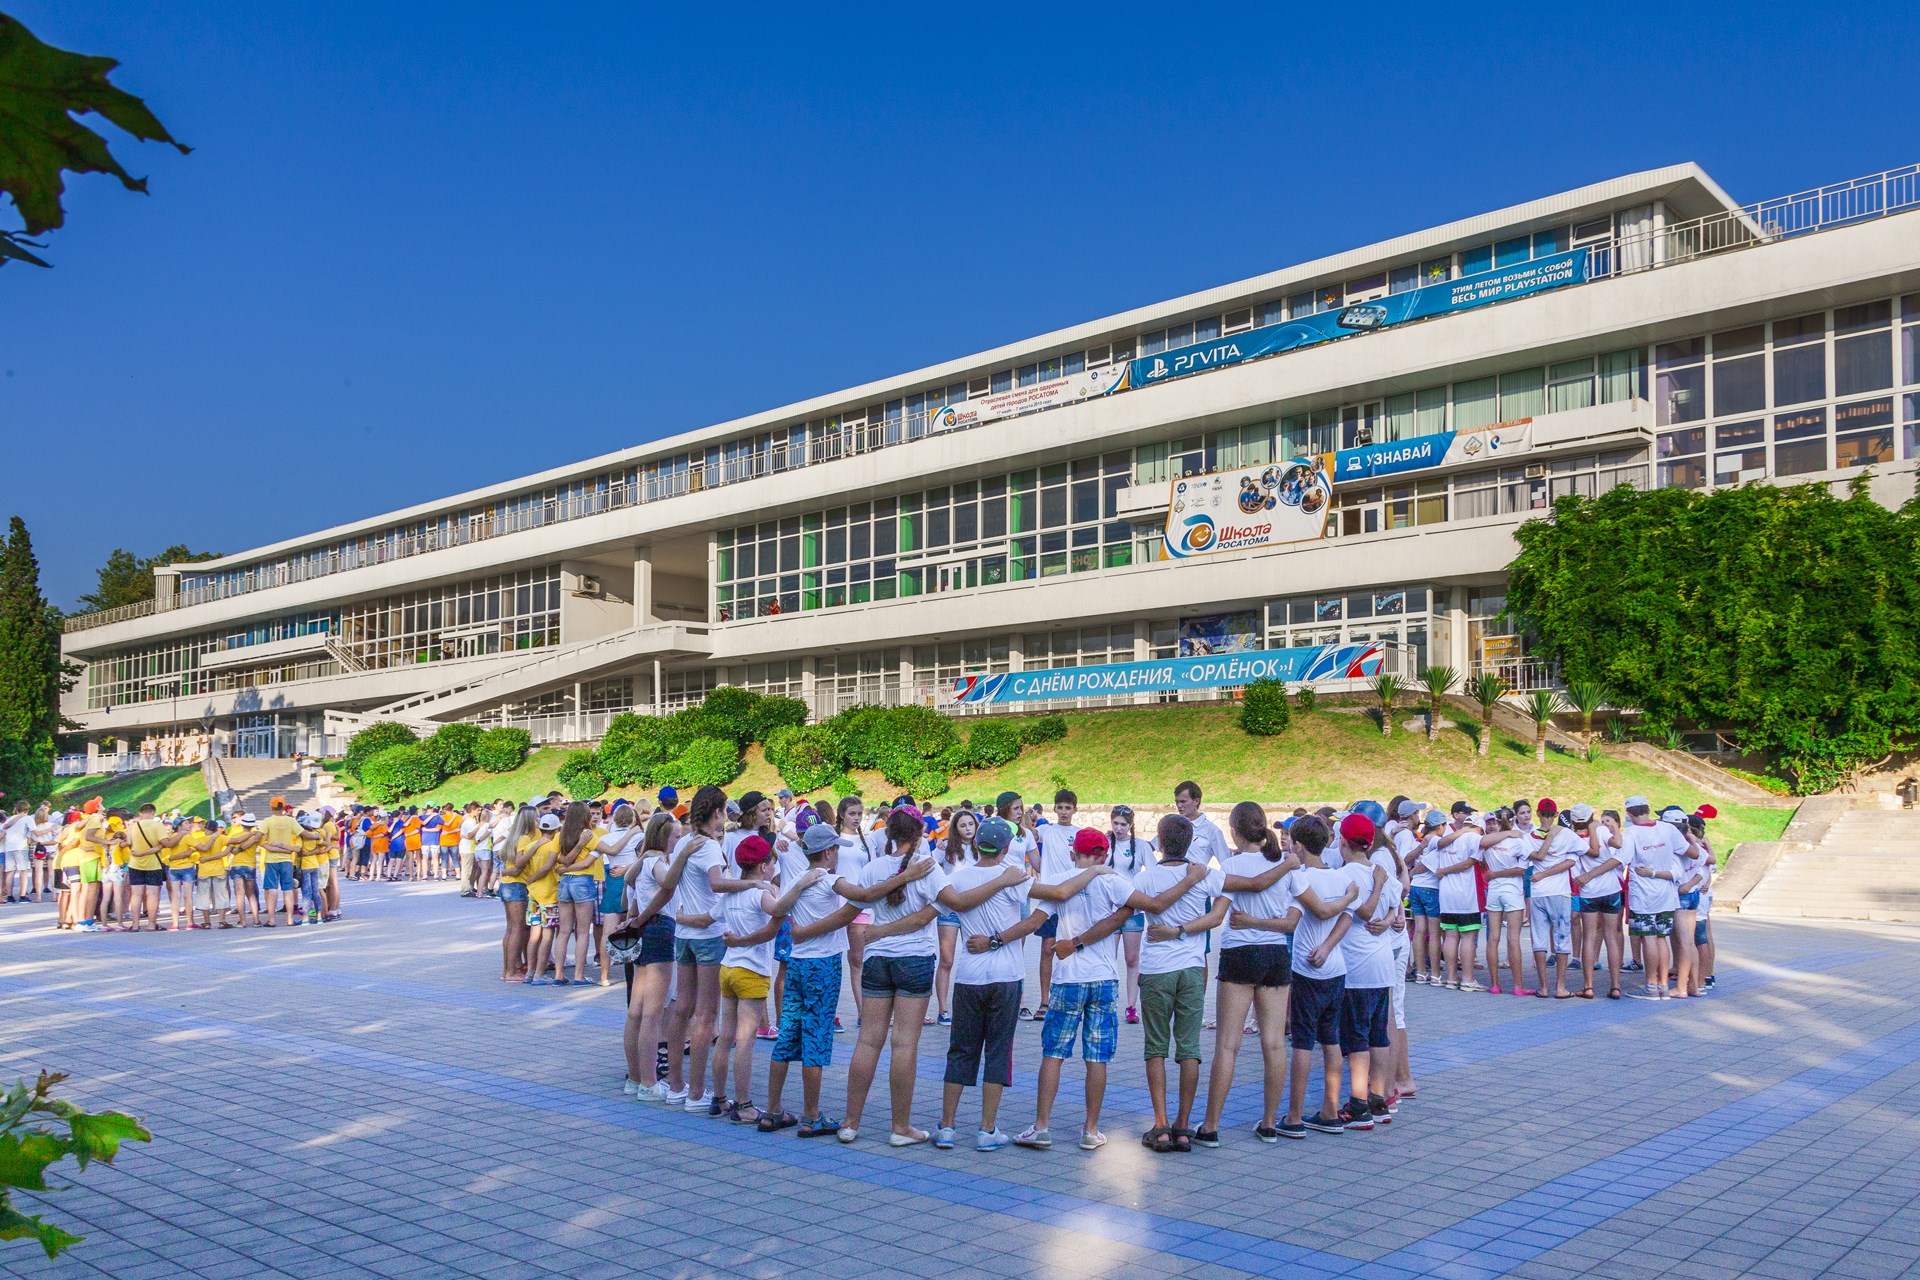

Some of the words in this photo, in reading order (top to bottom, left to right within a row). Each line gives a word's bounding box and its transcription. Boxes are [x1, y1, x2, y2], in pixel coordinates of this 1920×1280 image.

[1451, 283, 1472, 295] ЭТИМ
[1473, 277, 1501, 290] ЛЕТОМ
[1502, 269, 1536, 283] ВОЗЬМИ
[1544, 258, 1573, 273] СОБОЙ
[1451, 291, 1476, 305] ВЕСЬ
[1478, 285, 1502, 299] МИР
[1504, 269, 1573, 293] PLAYSTATION
[980, 394, 1011, 405] Отраслевая
[1011, 390, 1028, 398] смена
[1027, 387, 1039, 395] для
[1039, 380, 1069, 392] одаренных
[990, 402, 1006, 411] детей
[1006, 397, 1028, 407] городов
[1028, 389, 1059, 401] РОСАТОМА
[957, 410, 978, 420] Школа
[957, 417, 978, 425] РОСАТОМА
[1366, 441, 1431, 467] УЗНАВАЙ
[1216, 535, 1269, 550] РОСАТОМА
[1218, 522, 1272, 542] Школа
[1013, 678, 1026, 695] С
[1027, 672, 1075, 696] ДНЁМ
[1077, 666, 1176, 690] РОЖДЕНИЯ,
[1181, 657, 1294, 683] «ОРЛЁНОК»!
